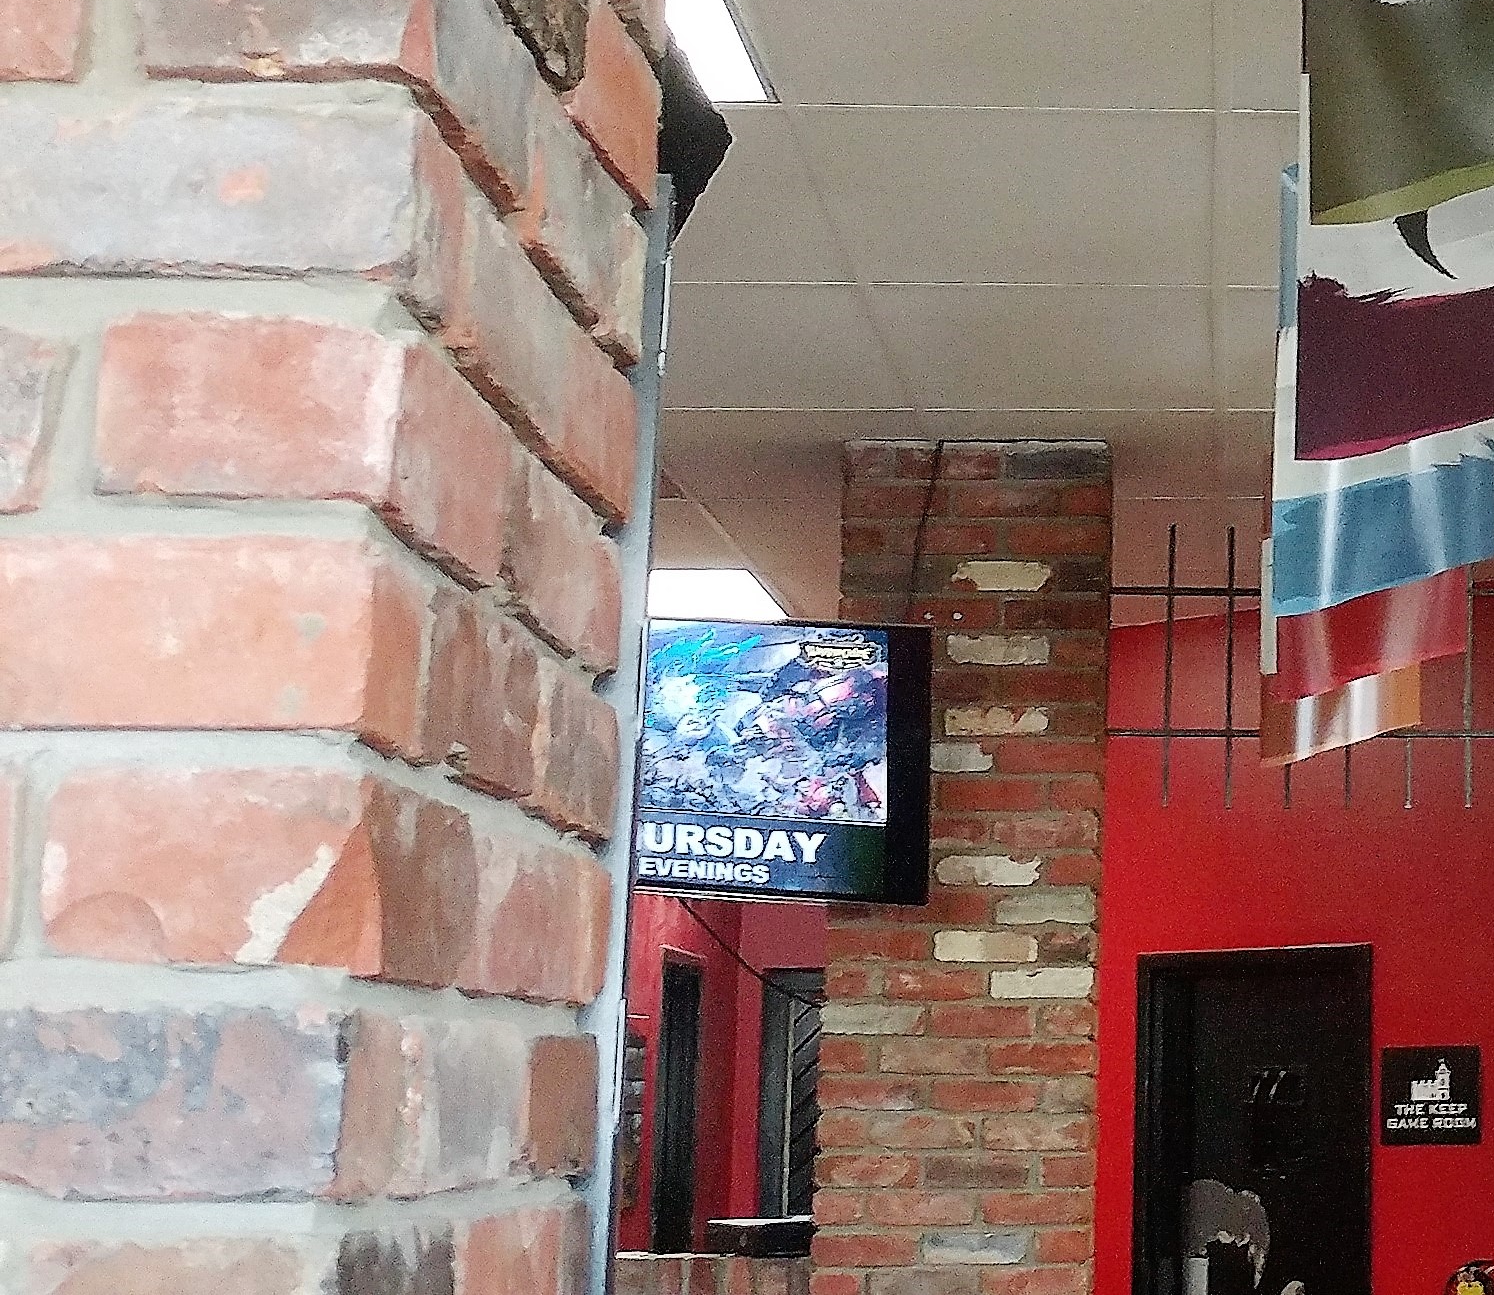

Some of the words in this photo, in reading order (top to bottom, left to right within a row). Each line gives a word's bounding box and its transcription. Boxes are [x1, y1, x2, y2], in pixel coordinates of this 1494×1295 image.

[637, 821, 828, 863] URSDAY
[638, 856, 770, 884] EVENINGS
[1394, 1104, 1425, 1115] THE
[1428, 1104, 1467, 1115] KEEP
[1386, 1118, 1429, 1129] GAME
[1431, 1118, 1477, 1129] ROOM
